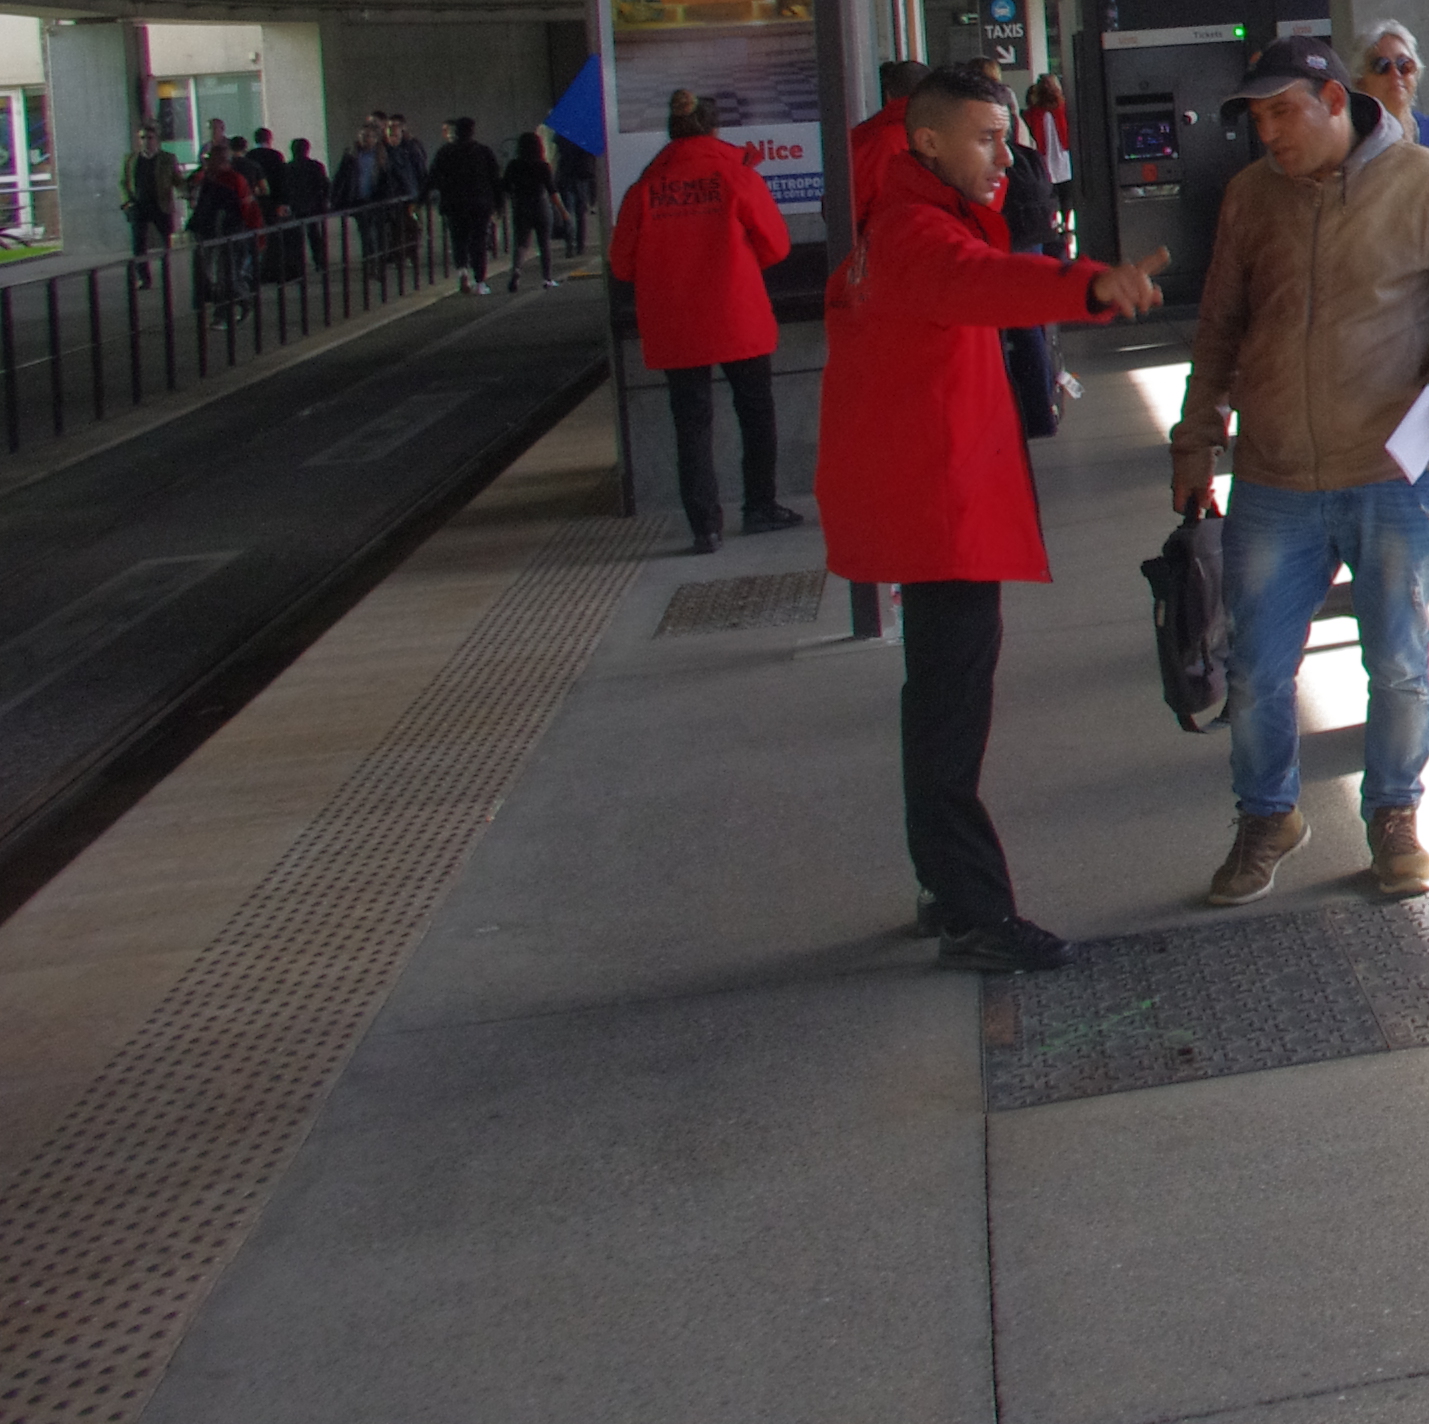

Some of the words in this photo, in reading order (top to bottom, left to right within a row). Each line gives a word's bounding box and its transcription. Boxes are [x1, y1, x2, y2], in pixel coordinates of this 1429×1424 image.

[984, 23, 1024, 39] TAXIS
[1193, 31, 1223, 40] Tickets
[745, 140, 804, 160] Nice
[767, 177, 823, 191] MÉTROPO
